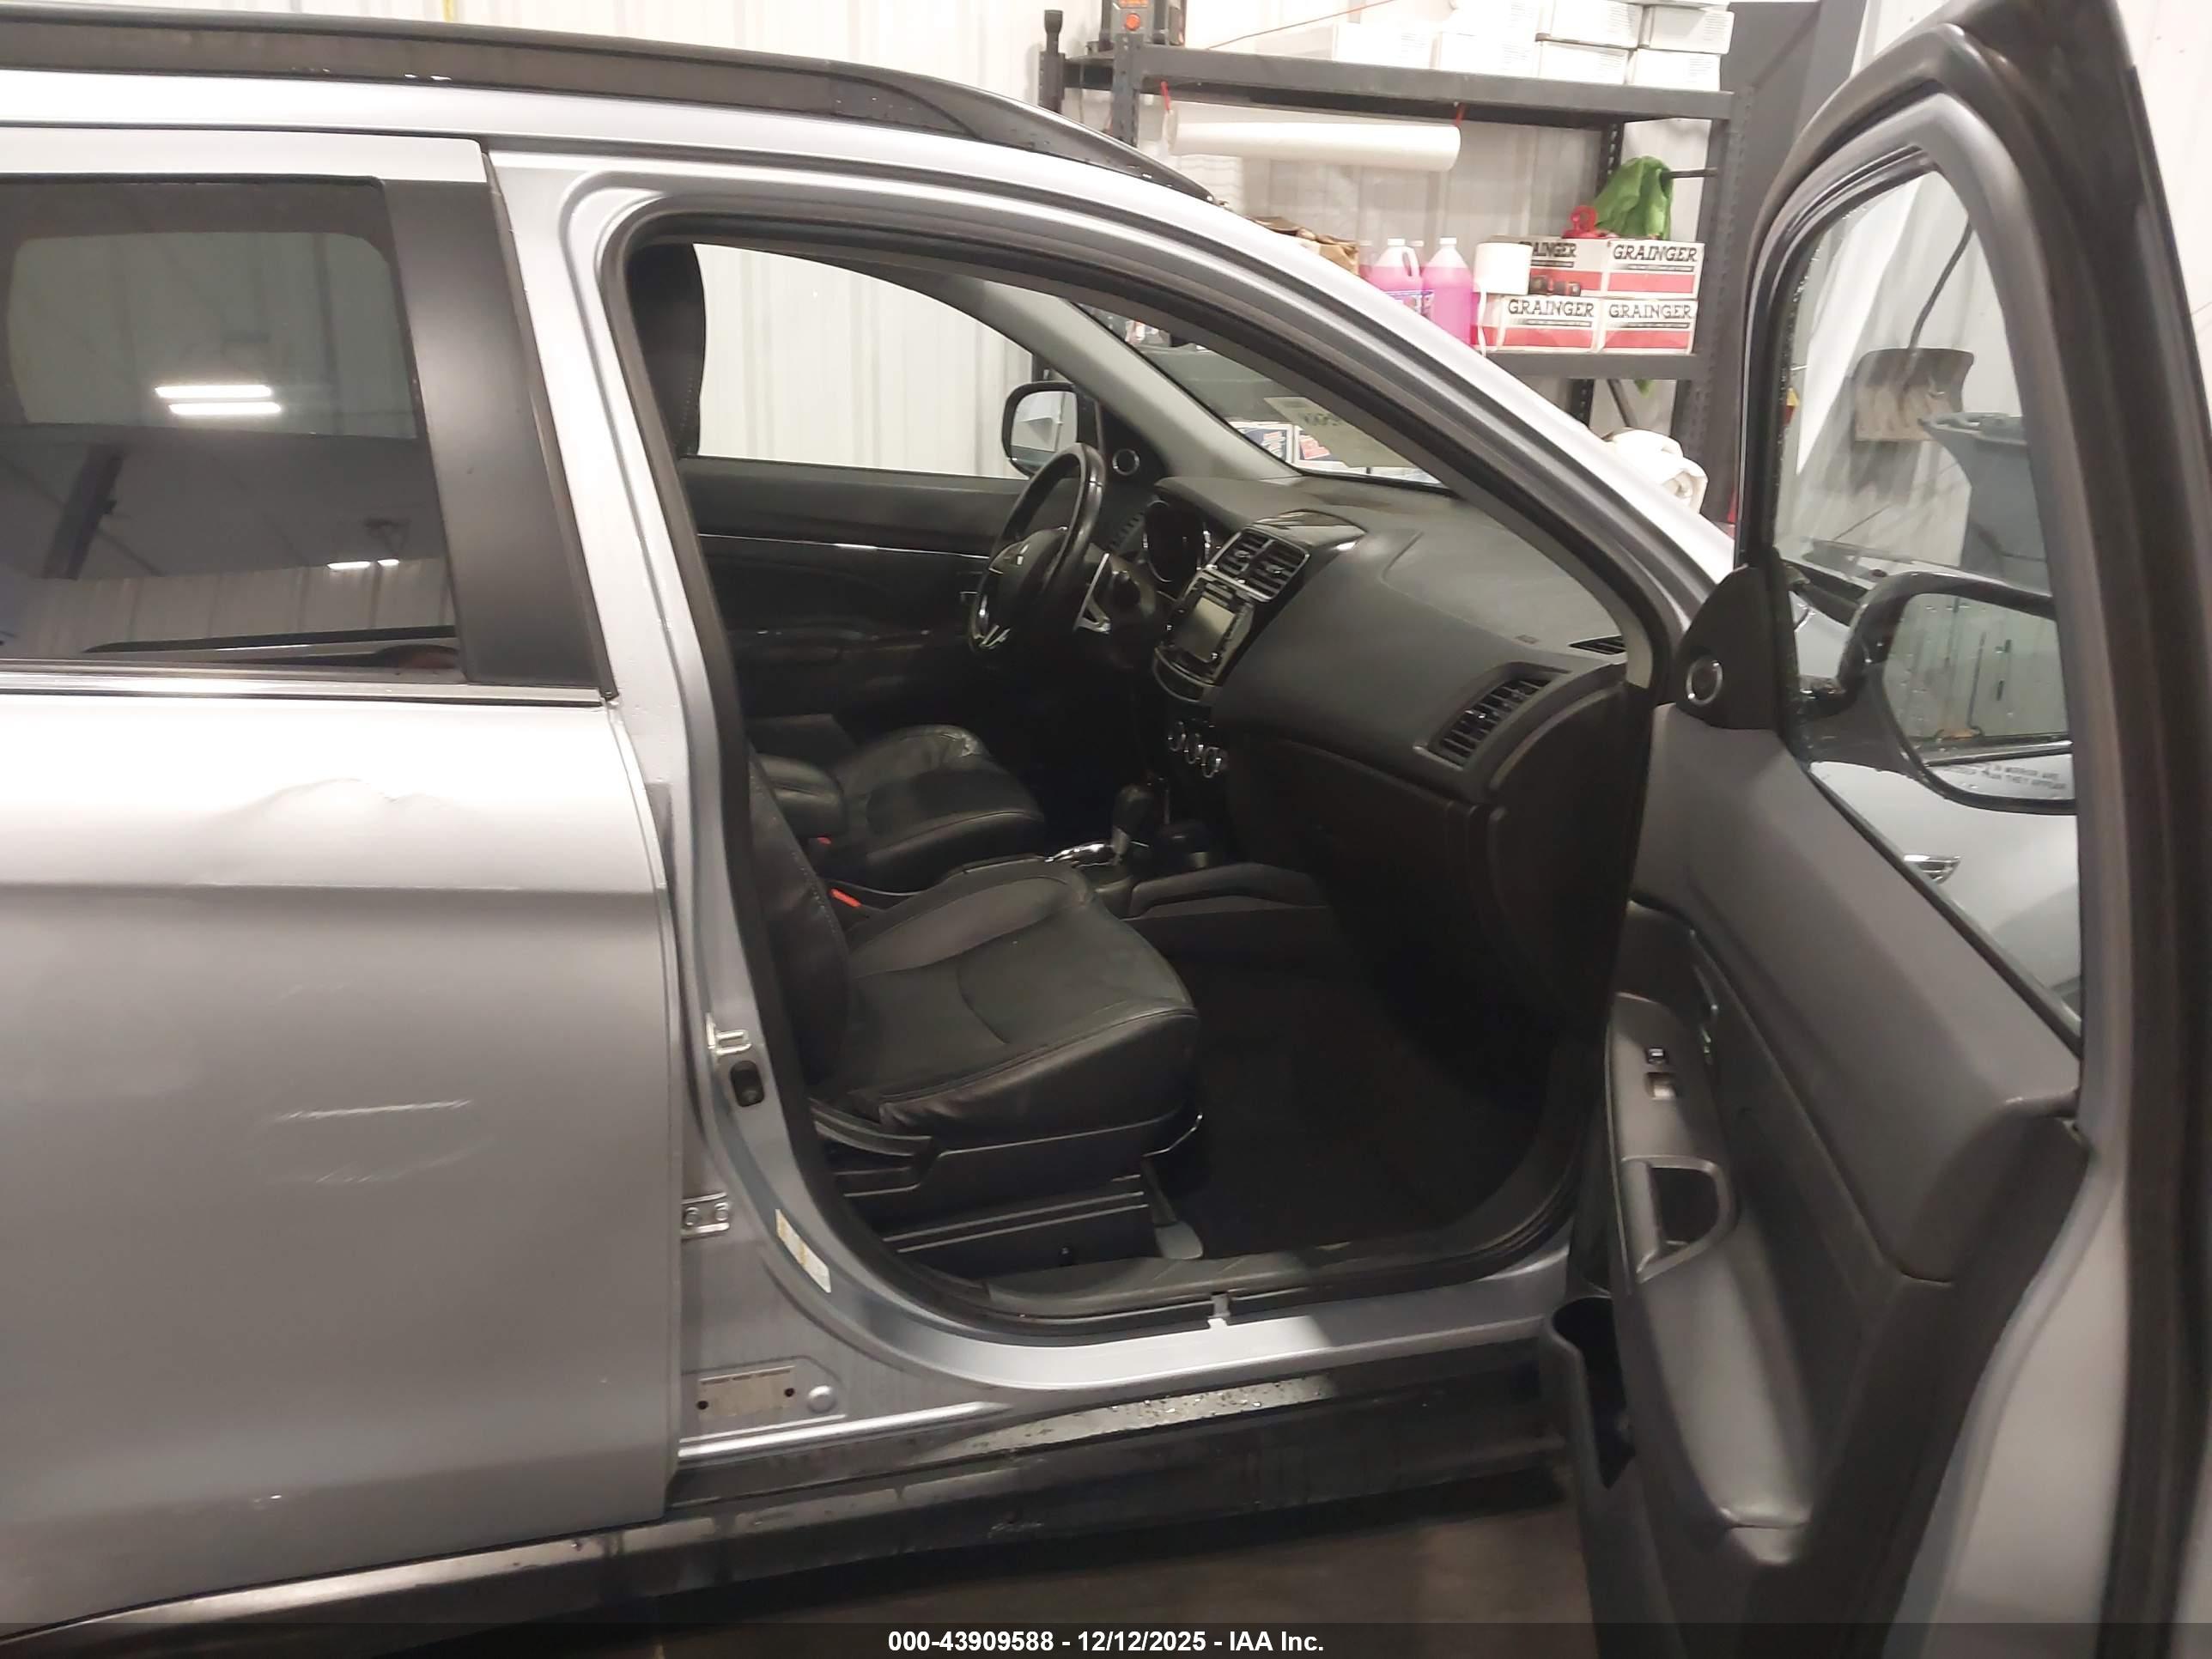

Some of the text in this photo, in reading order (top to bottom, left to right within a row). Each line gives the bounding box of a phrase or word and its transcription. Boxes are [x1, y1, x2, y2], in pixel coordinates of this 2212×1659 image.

[1518, 241, 1577, 258] AINGER
[1613, 244, 1698, 262] GRAINGER
[1508, 299, 1595, 318] GRAINGER
[1608, 304, 1694, 319] GRAINGER
